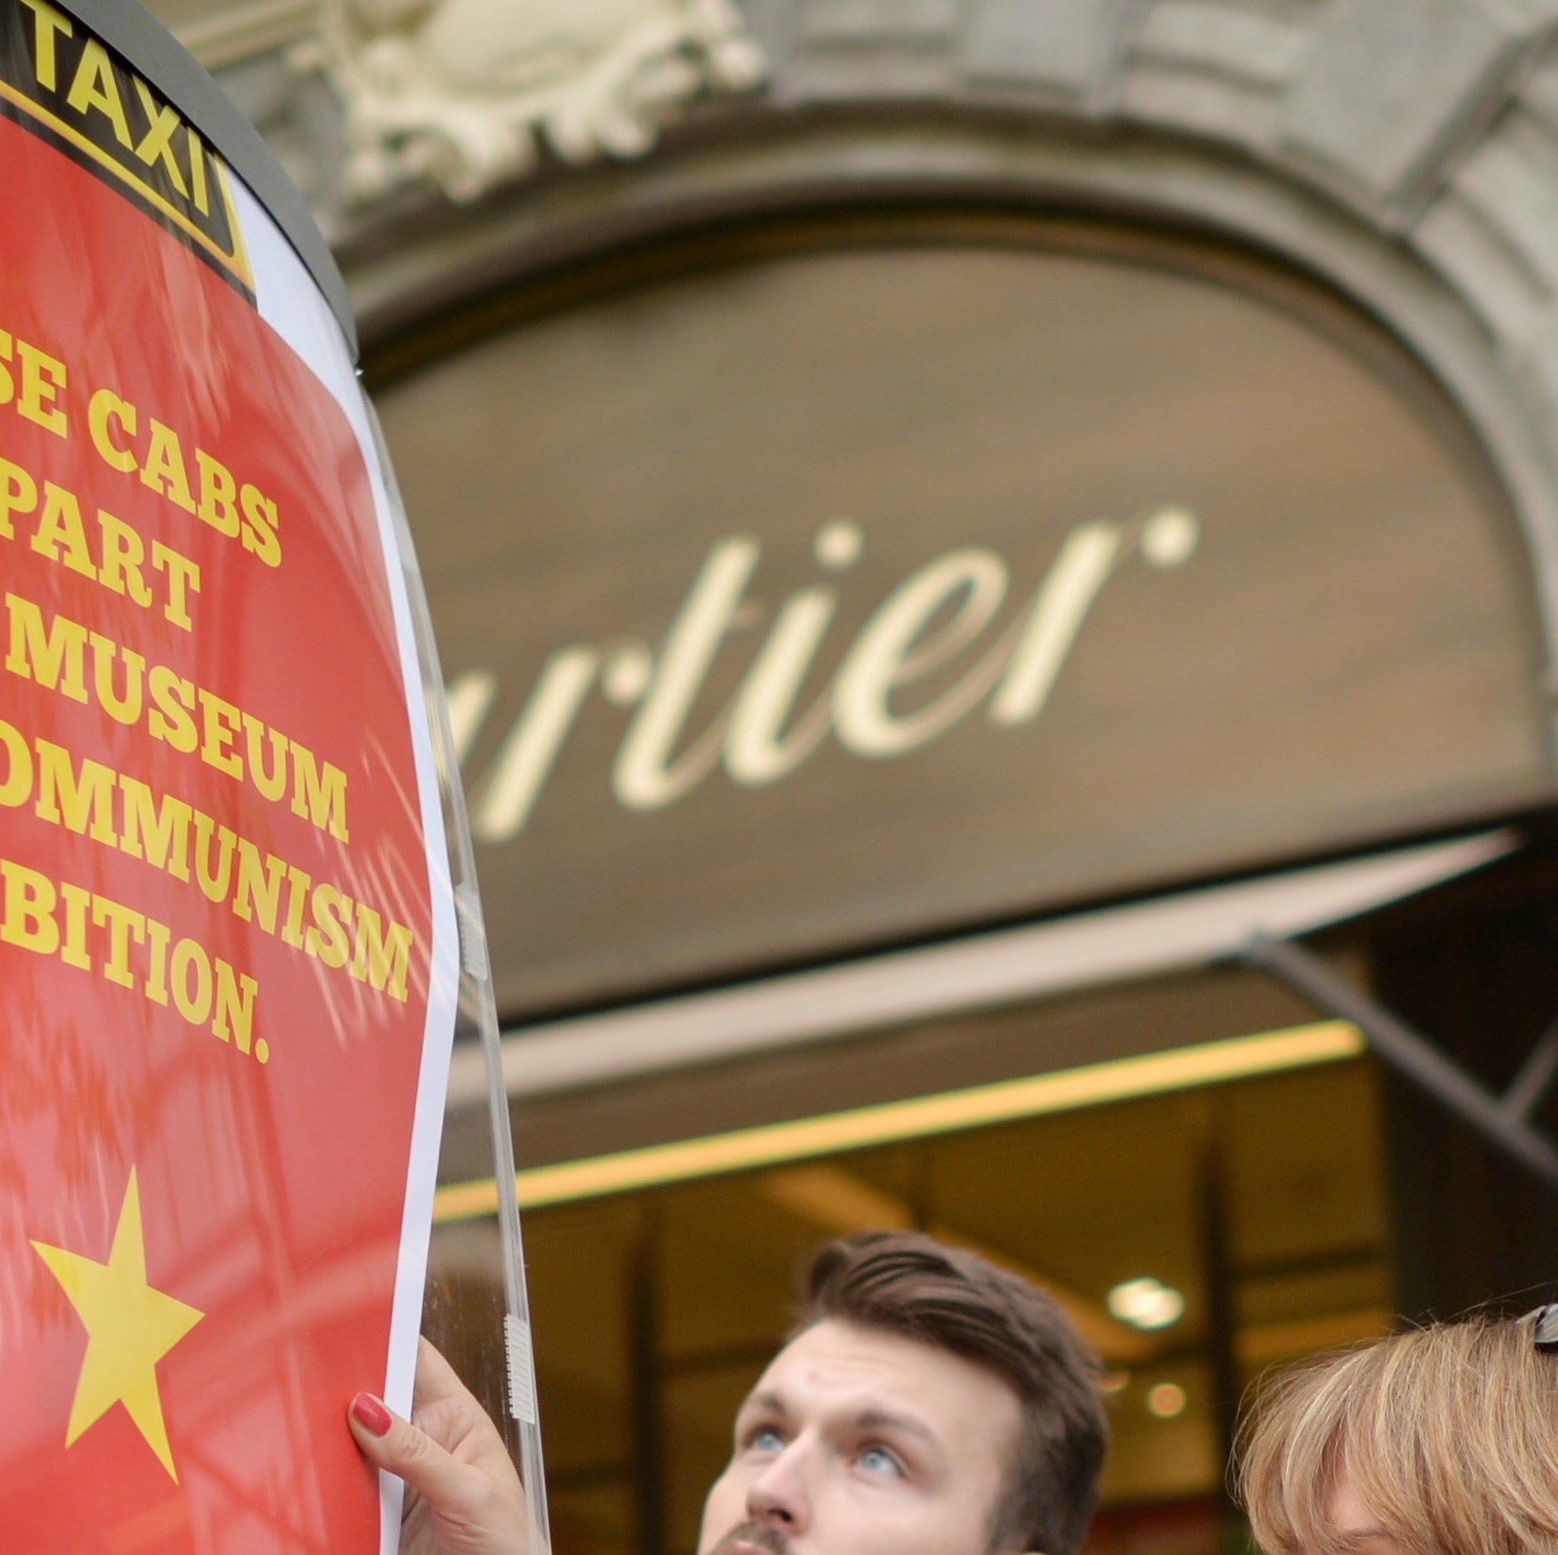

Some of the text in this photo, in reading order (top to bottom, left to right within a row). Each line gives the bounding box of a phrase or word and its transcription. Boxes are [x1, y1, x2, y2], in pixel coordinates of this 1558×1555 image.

[20, 0, 210, 218] TAXI
[88, 389, 283, 568] CABS
[5, 591, 350, 844] MUSEUM
